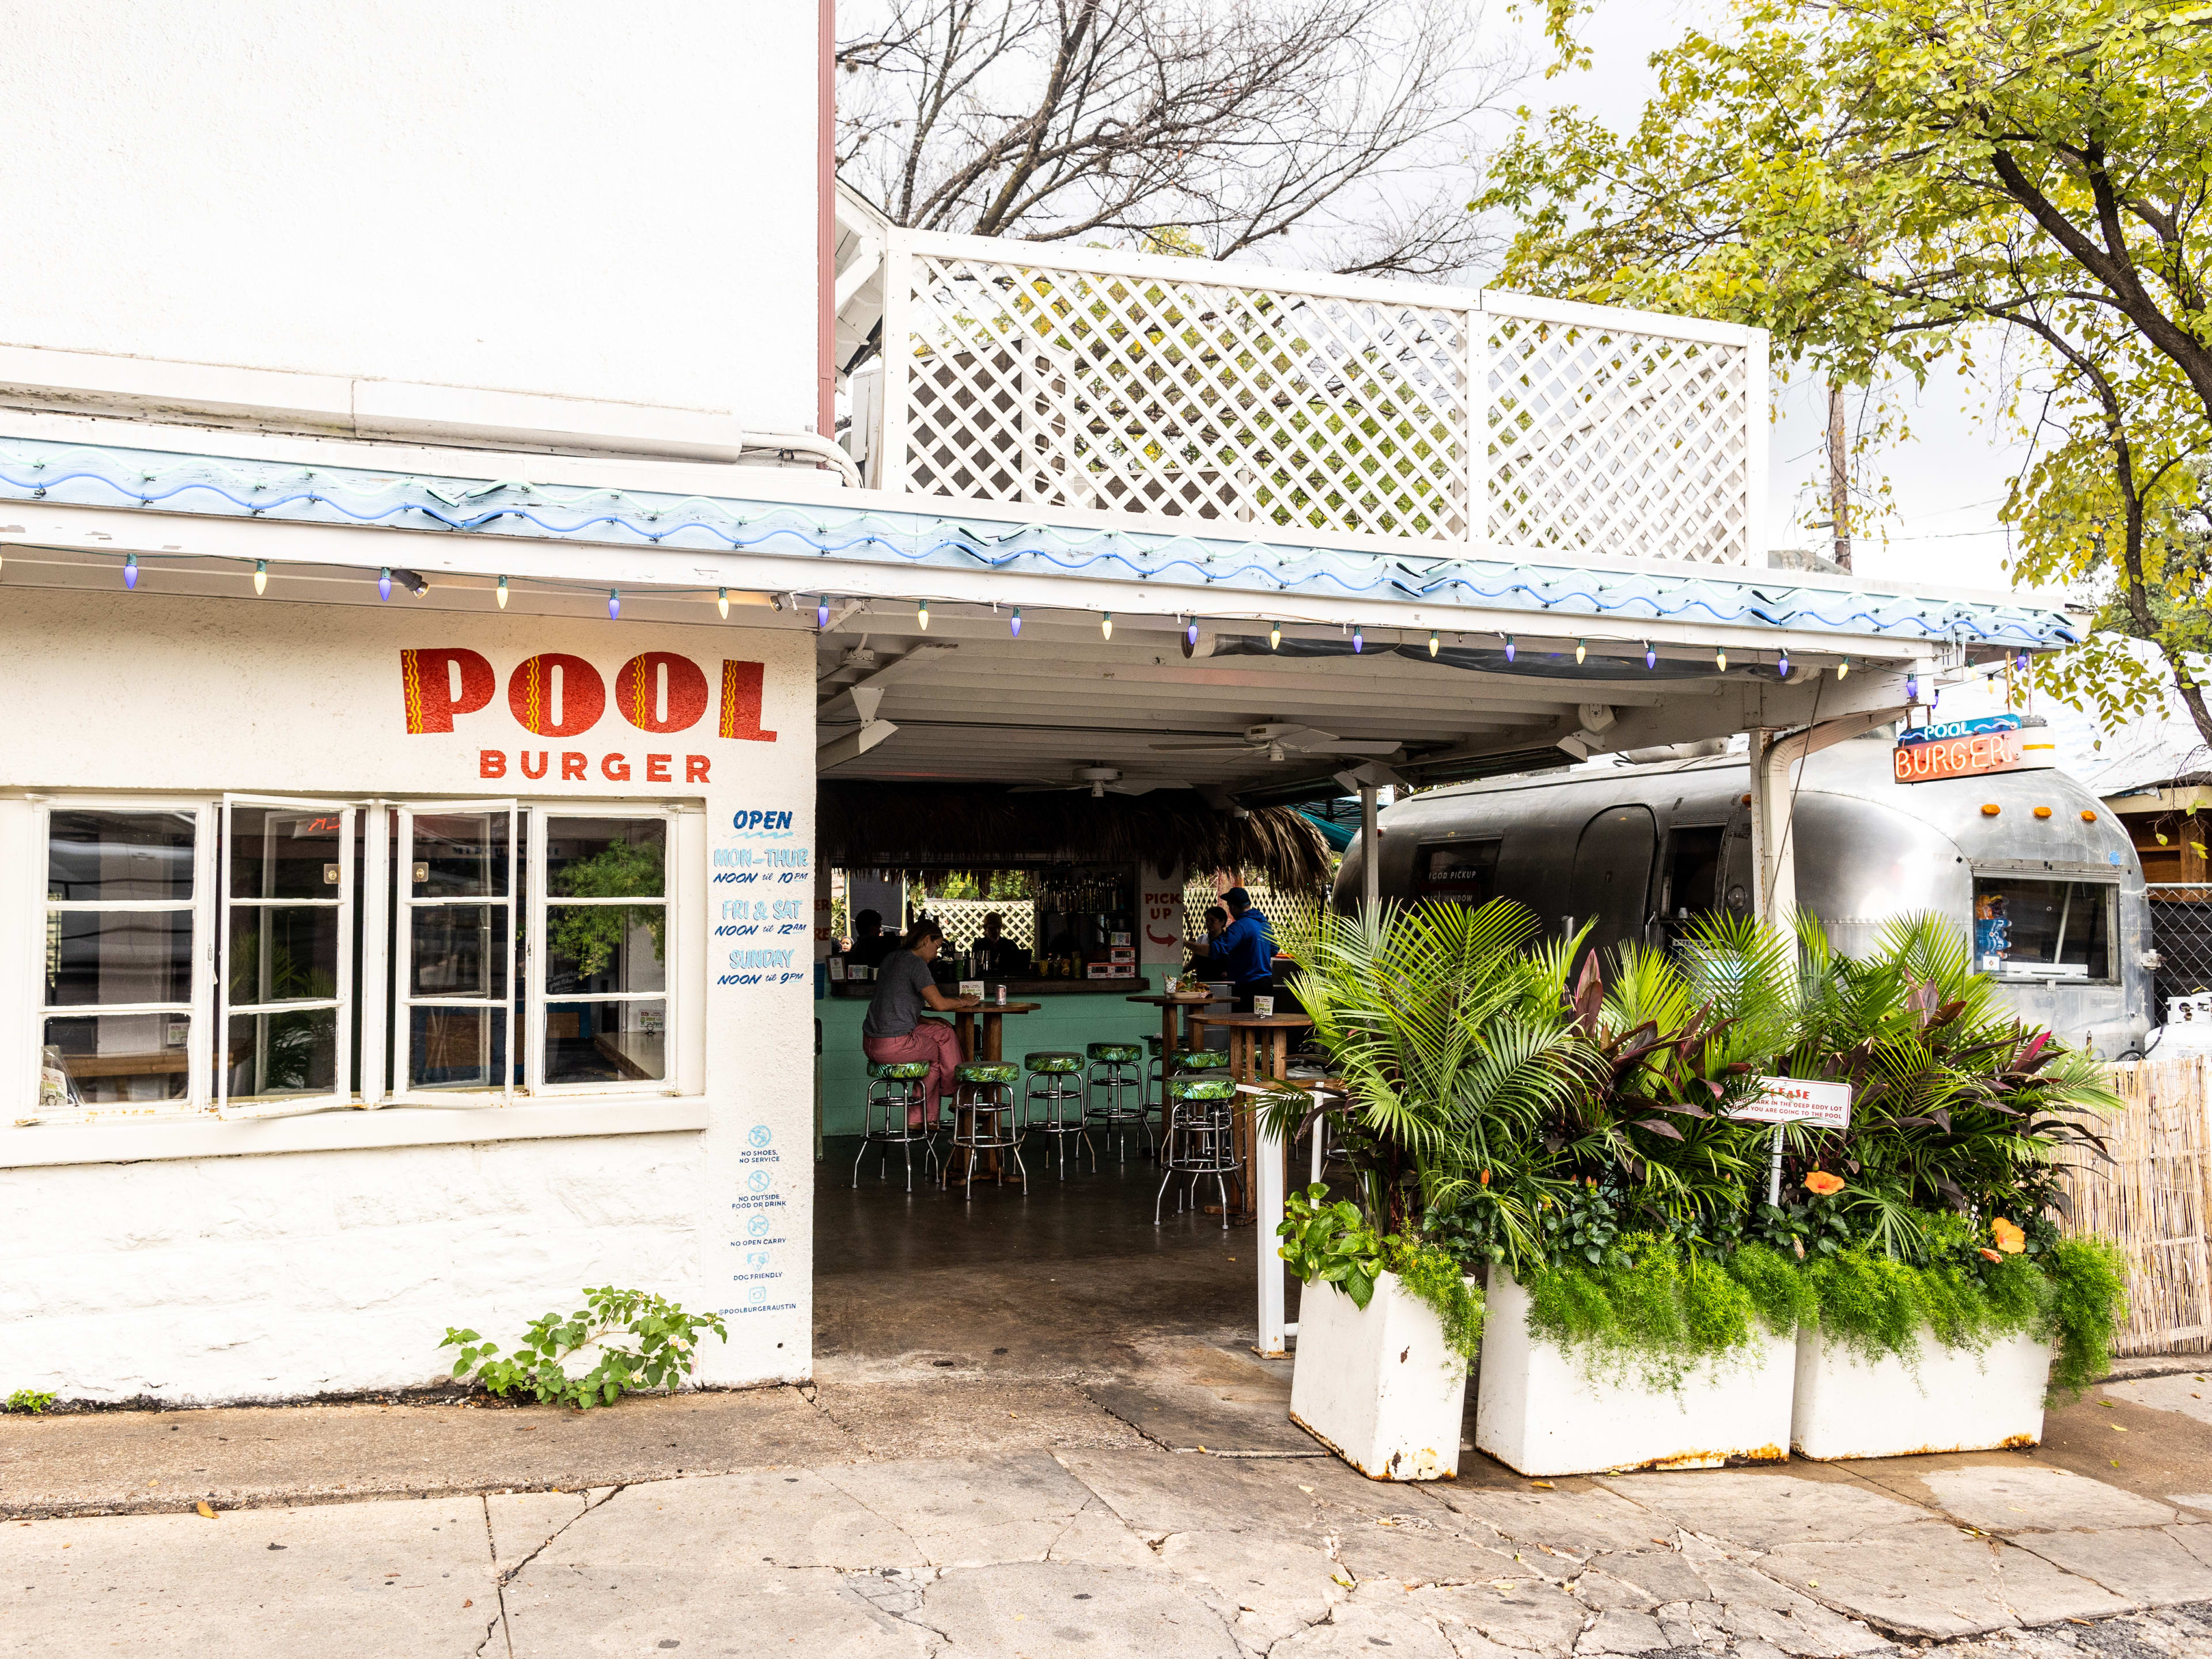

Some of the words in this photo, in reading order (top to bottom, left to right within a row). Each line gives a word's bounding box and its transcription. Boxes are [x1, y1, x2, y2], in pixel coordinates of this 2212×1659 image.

[400, 647, 778, 743] POOL
[1924, 722, 1973, 741] POOL
[1895, 736, 2013, 778] BURGER
[479, 750, 711, 783] BURGER
[733, 810, 793, 830] OPEN
[713, 872, 758, 884] NOON
[762, 873, 773, 881] til
[1450, 871, 1476, 879] PICKUP
[1145, 892, 1183, 905] PICK
[722, 900, 749, 920] FRI
[753, 900, 768, 921] &
[773, 899, 804, 920] SAT
[1150, 907, 1172, 920] UP
[714, 924, 759, 936] NOON
[763, 925, 774, 933] til
[729, 949, 795, 969] SUNDAY
[717, 974, 762, 985] NOON
[765, 974, 777, 982] til
[718, 1304, 796, 1315] @POOLBURGERAUSTIN
